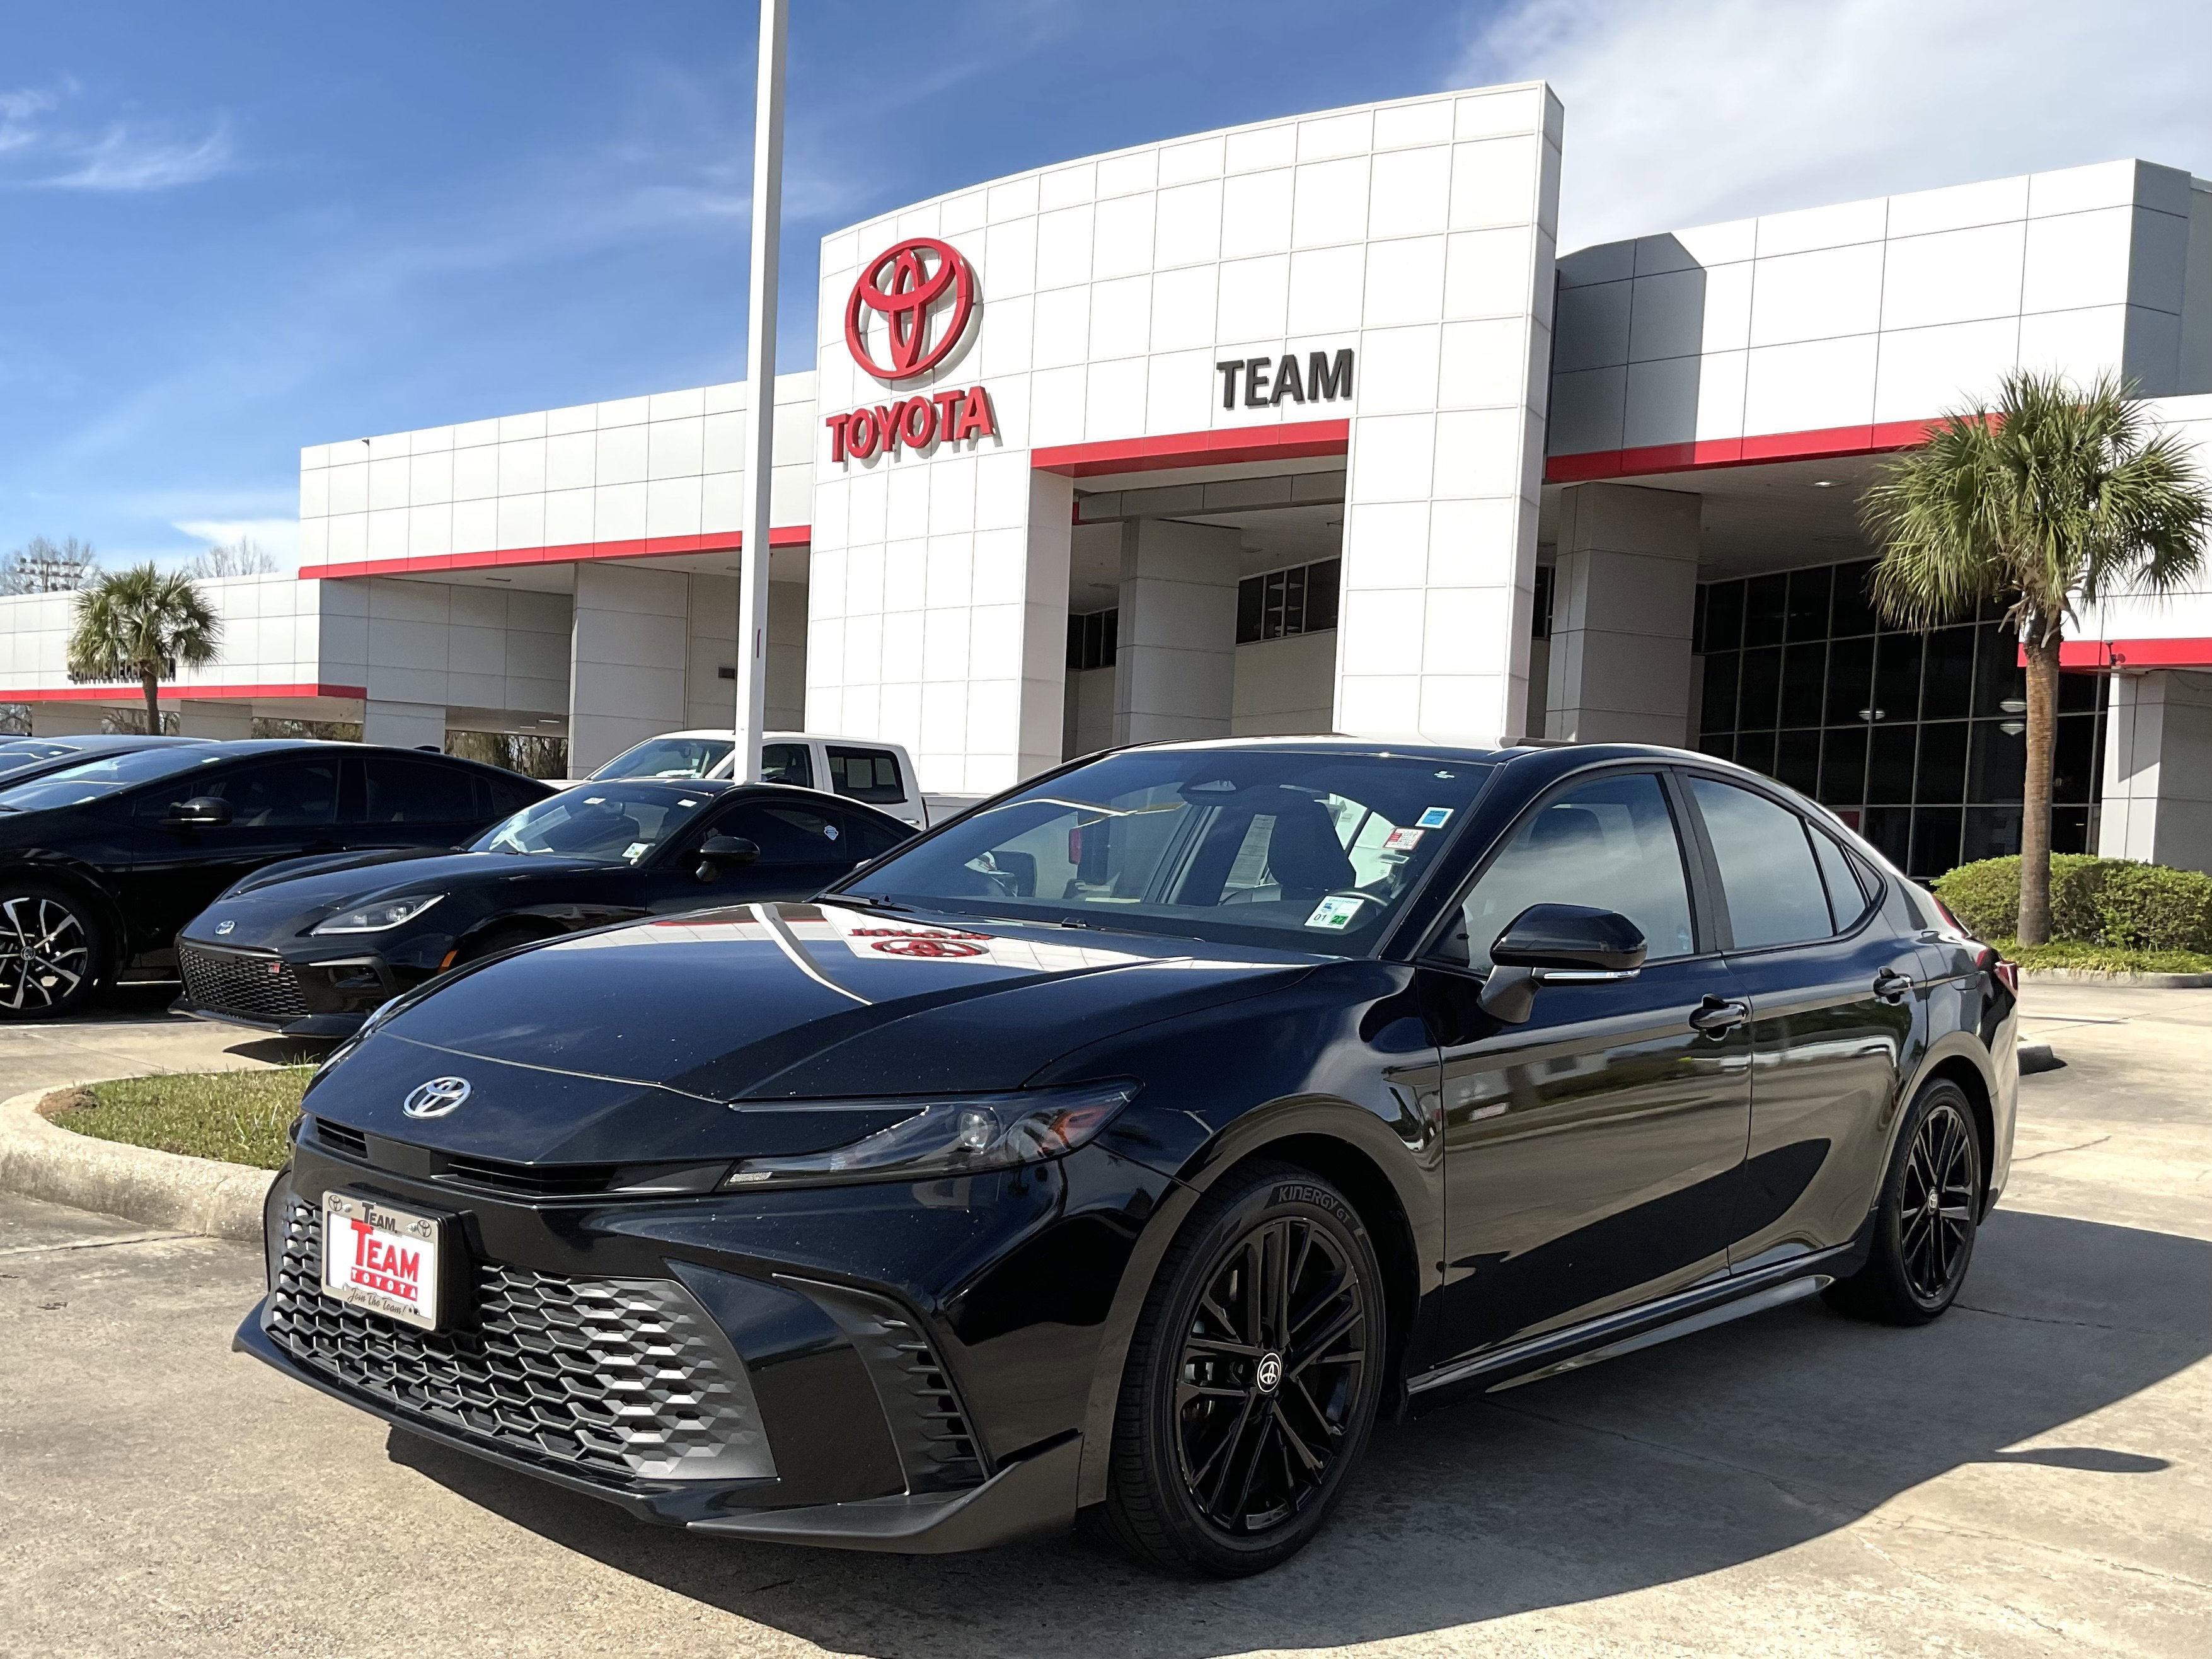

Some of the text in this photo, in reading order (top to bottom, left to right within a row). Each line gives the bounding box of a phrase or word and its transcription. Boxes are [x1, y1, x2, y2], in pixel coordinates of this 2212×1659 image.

[1216, 348, 1353, 408] TEAM
[826, 385, 996, 463] TOYOTA
[1313, 913, 1327, 922] 01
[1278, 1186, 1351, 1223] KINERGY GT
[350, 1218, 420, 1283] TEAM
[347, 1287, 366, 1303] Join
[352, 1269, 417, 1298] TOYOTA
